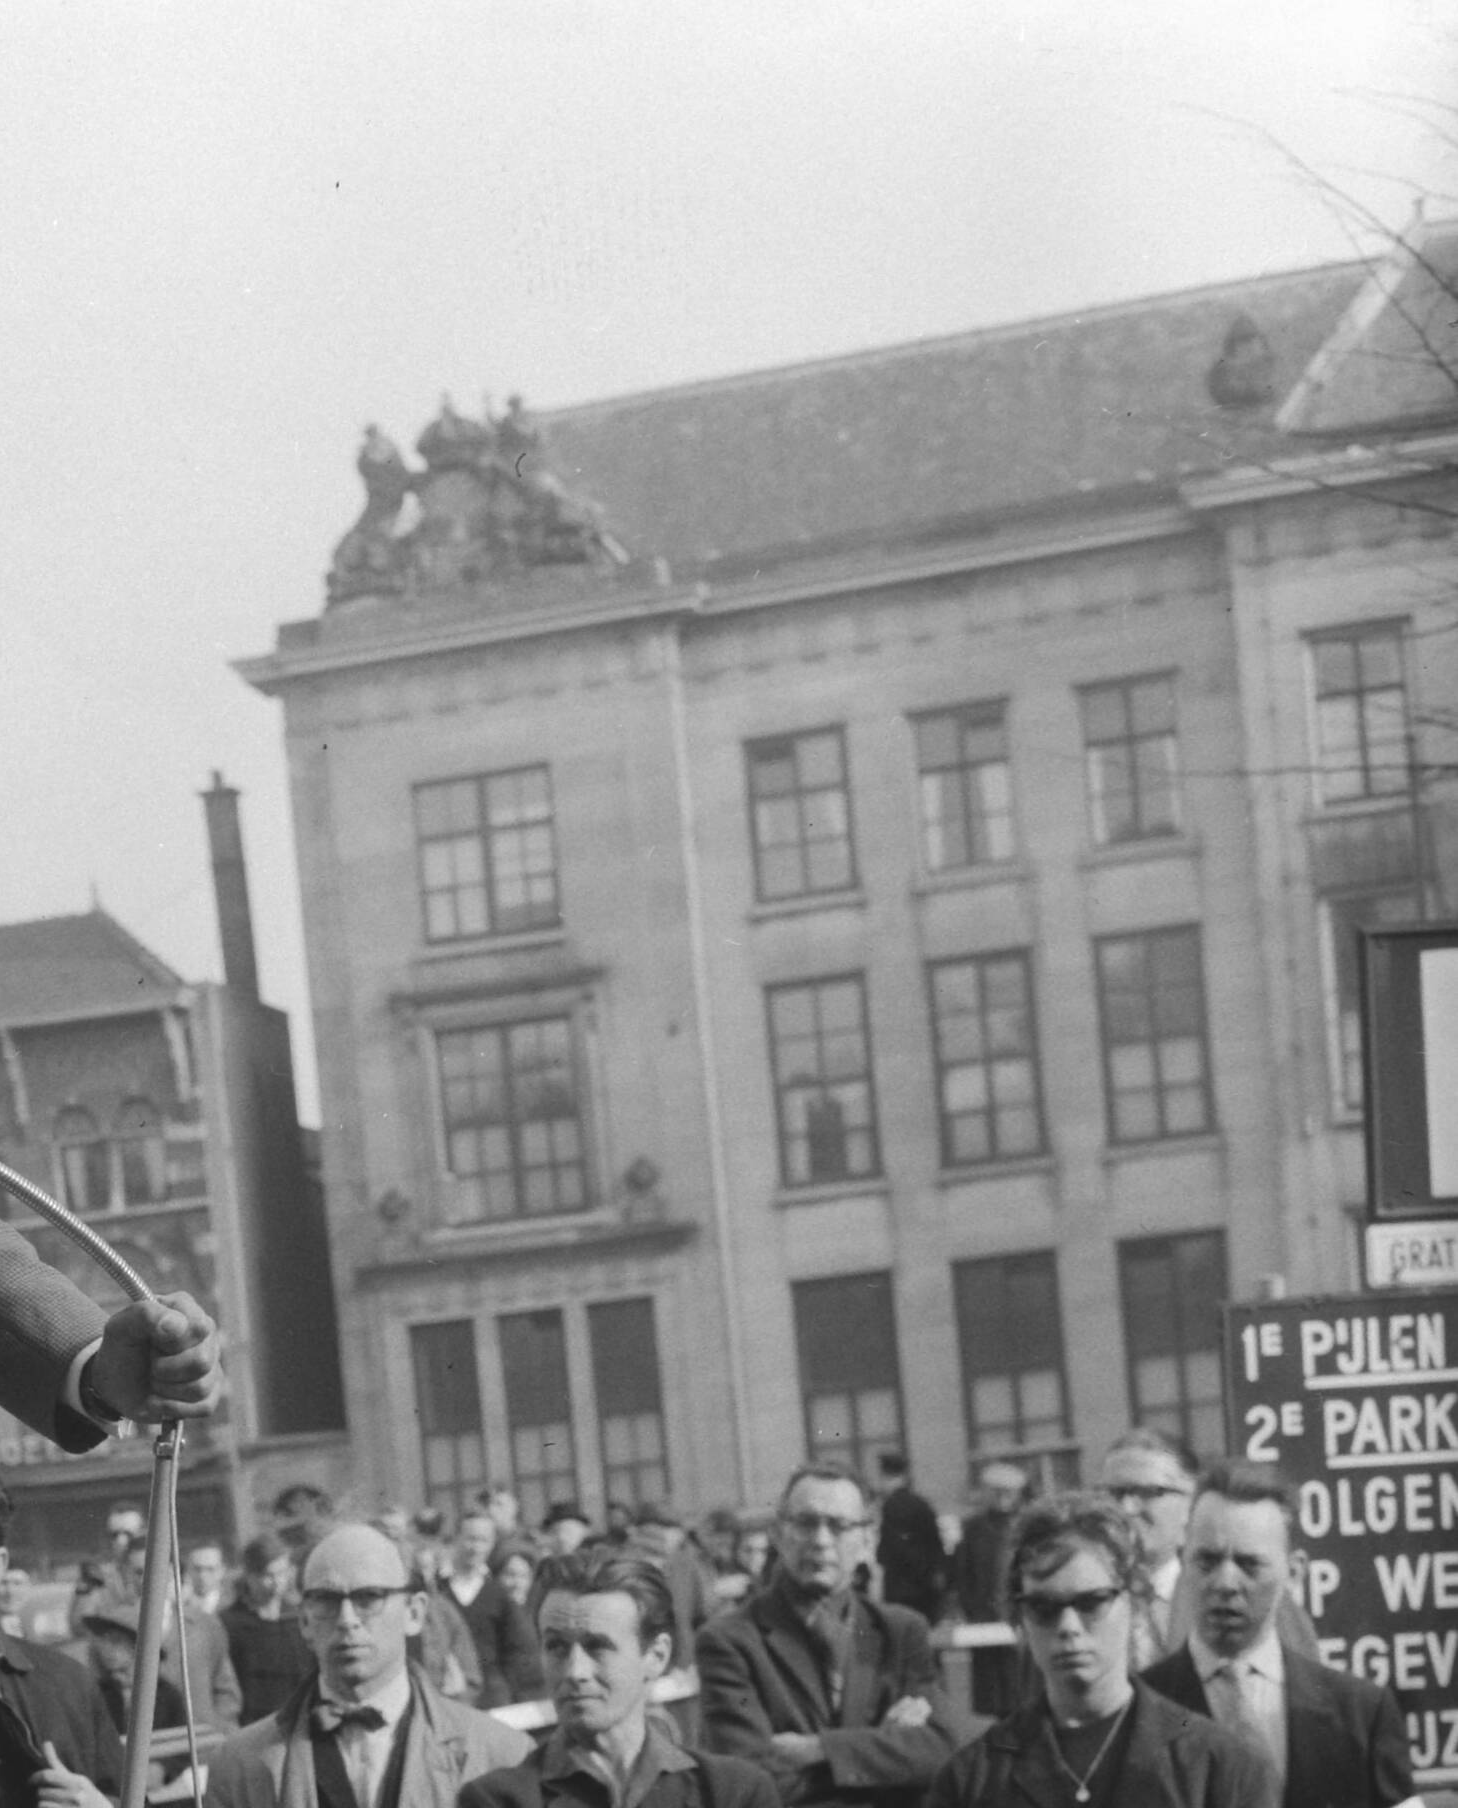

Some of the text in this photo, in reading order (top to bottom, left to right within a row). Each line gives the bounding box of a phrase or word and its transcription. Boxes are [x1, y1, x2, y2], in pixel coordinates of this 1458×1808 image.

[1245, 1392, 1458, 1462] 2E PARK
[1374, 1552, 1458, 1612] WE
